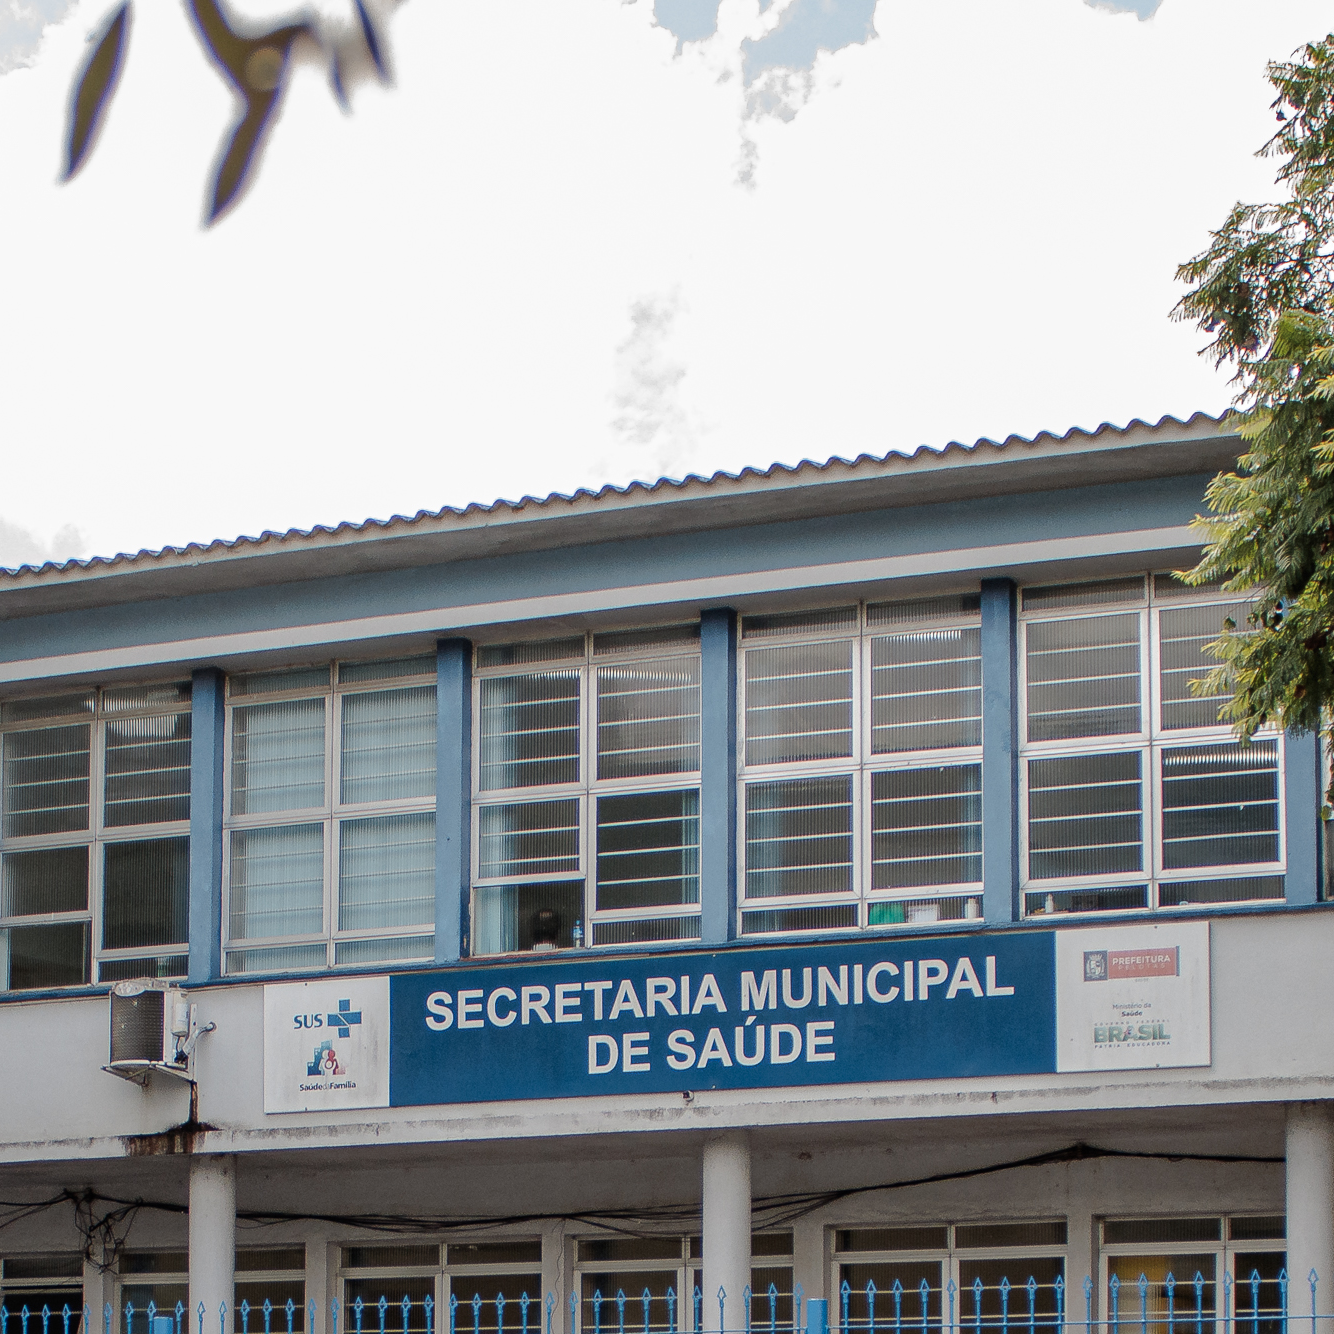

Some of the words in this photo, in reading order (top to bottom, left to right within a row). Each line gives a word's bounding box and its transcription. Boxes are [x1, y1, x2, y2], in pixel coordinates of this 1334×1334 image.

[1112, 954, 1171, 965] PREFEITURA
[1118, 963, 1166, 971] PELOTAS
[425, 973, 727, 1031] SECRETARIA
[740, 955, 1015, 1012] MUNICIPAL
[1112, 1002, 1142, 1010] Ministério
[293, 1013, 323, 1029] SUS
[1094, 1023, 1171, 1044] BRASIL
[588, 1032, 650, 1075] DE
[666, 1015, 836, 1070] SAÚDE
[299, 1083, 323, 1091] Saúde
[329, 1081, 357, 1090] Família
